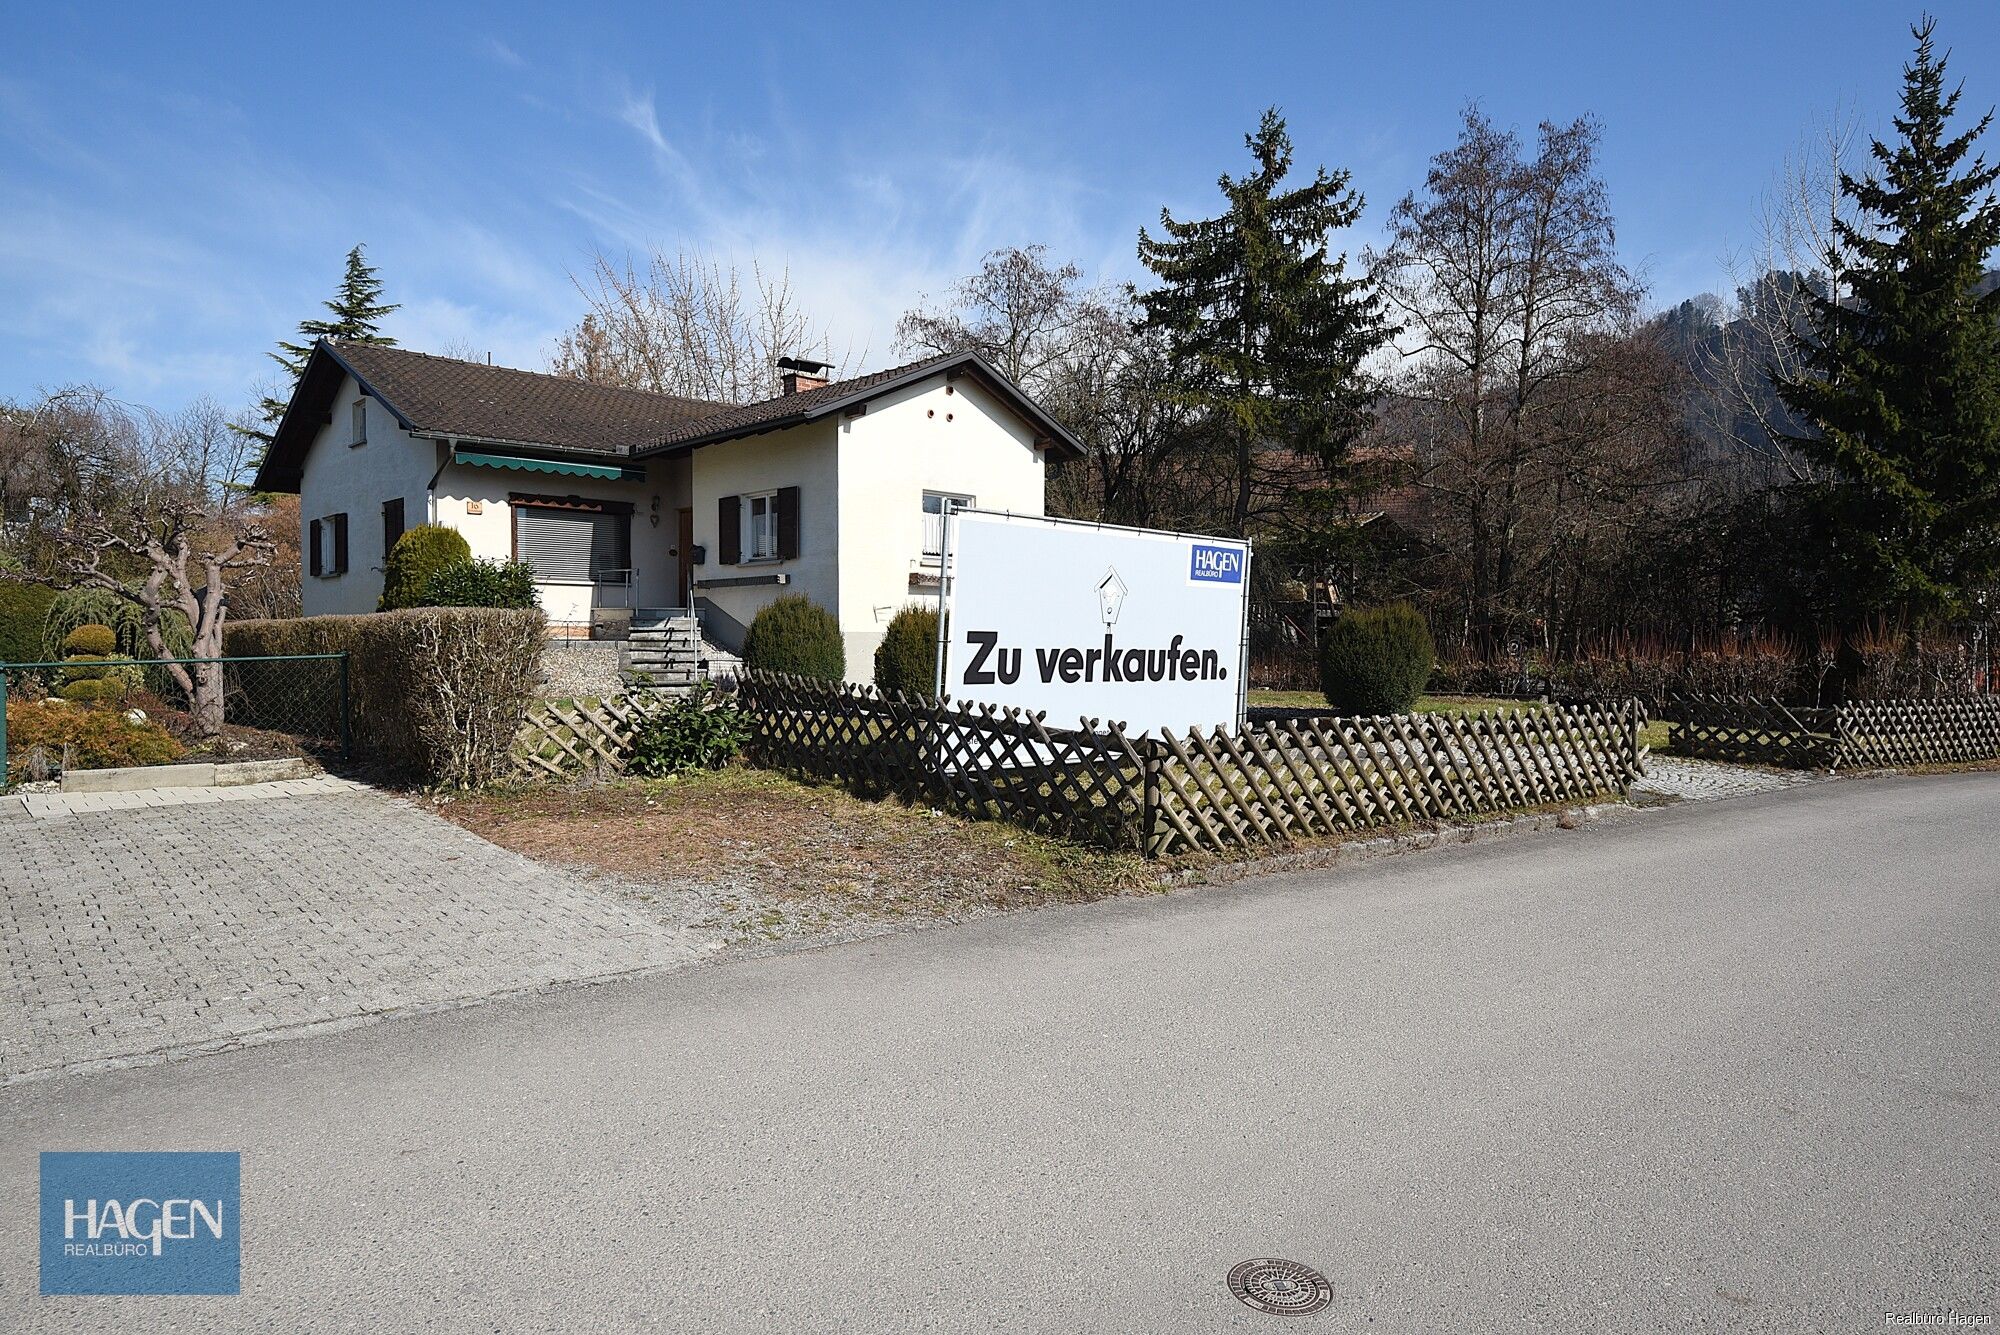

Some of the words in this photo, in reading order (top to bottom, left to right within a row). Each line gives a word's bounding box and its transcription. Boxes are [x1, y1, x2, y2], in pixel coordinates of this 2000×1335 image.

[1195, 549, 1239, 578] HAGEN
[1195, 569, 1218, 577] REALBÜRO
[963, 631, 1021, 685] Zu
[1036, 634, 1227, 683] verkaufen.
